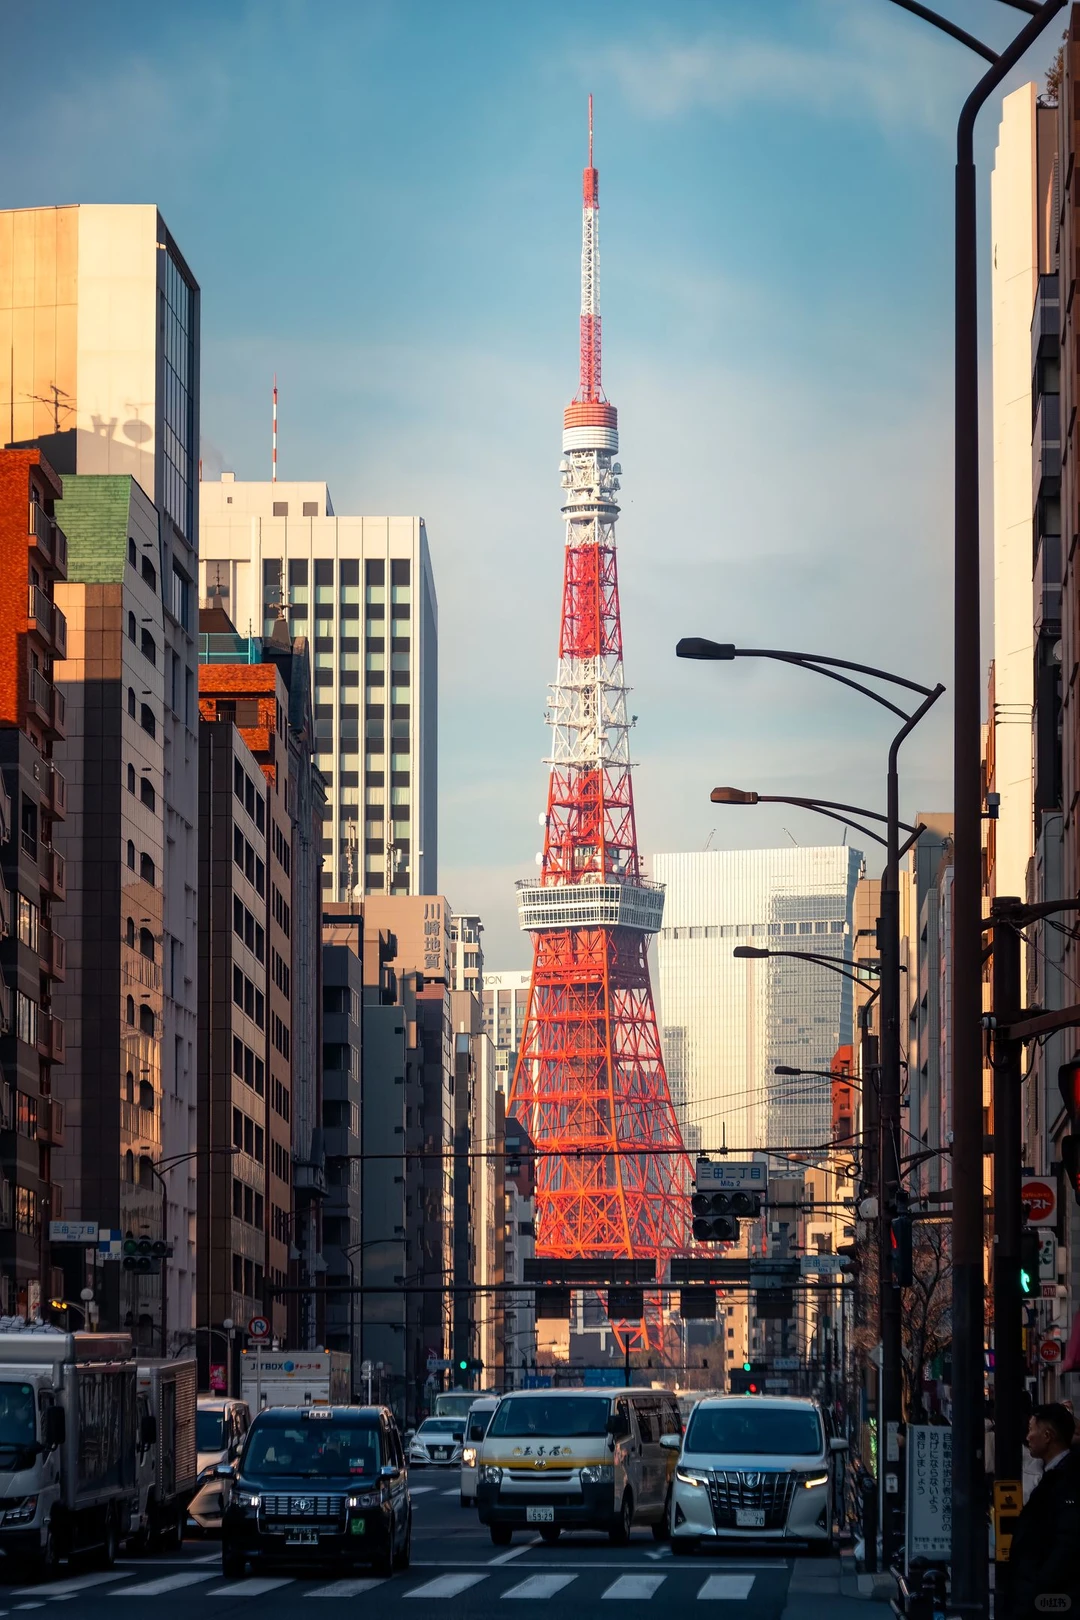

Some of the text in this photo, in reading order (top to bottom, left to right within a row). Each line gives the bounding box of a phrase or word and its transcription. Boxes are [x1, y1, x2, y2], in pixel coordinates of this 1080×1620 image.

[424, 903, 441, 970] 川崎地質
[701, 1167, 761, 1179] 三田二丁目
[53, 1225, 95, 1235] 三田二丁目
[1043, 1286, 1056, 1297] ATM
[917, 1431, 926, 1496] 通行しましょう
